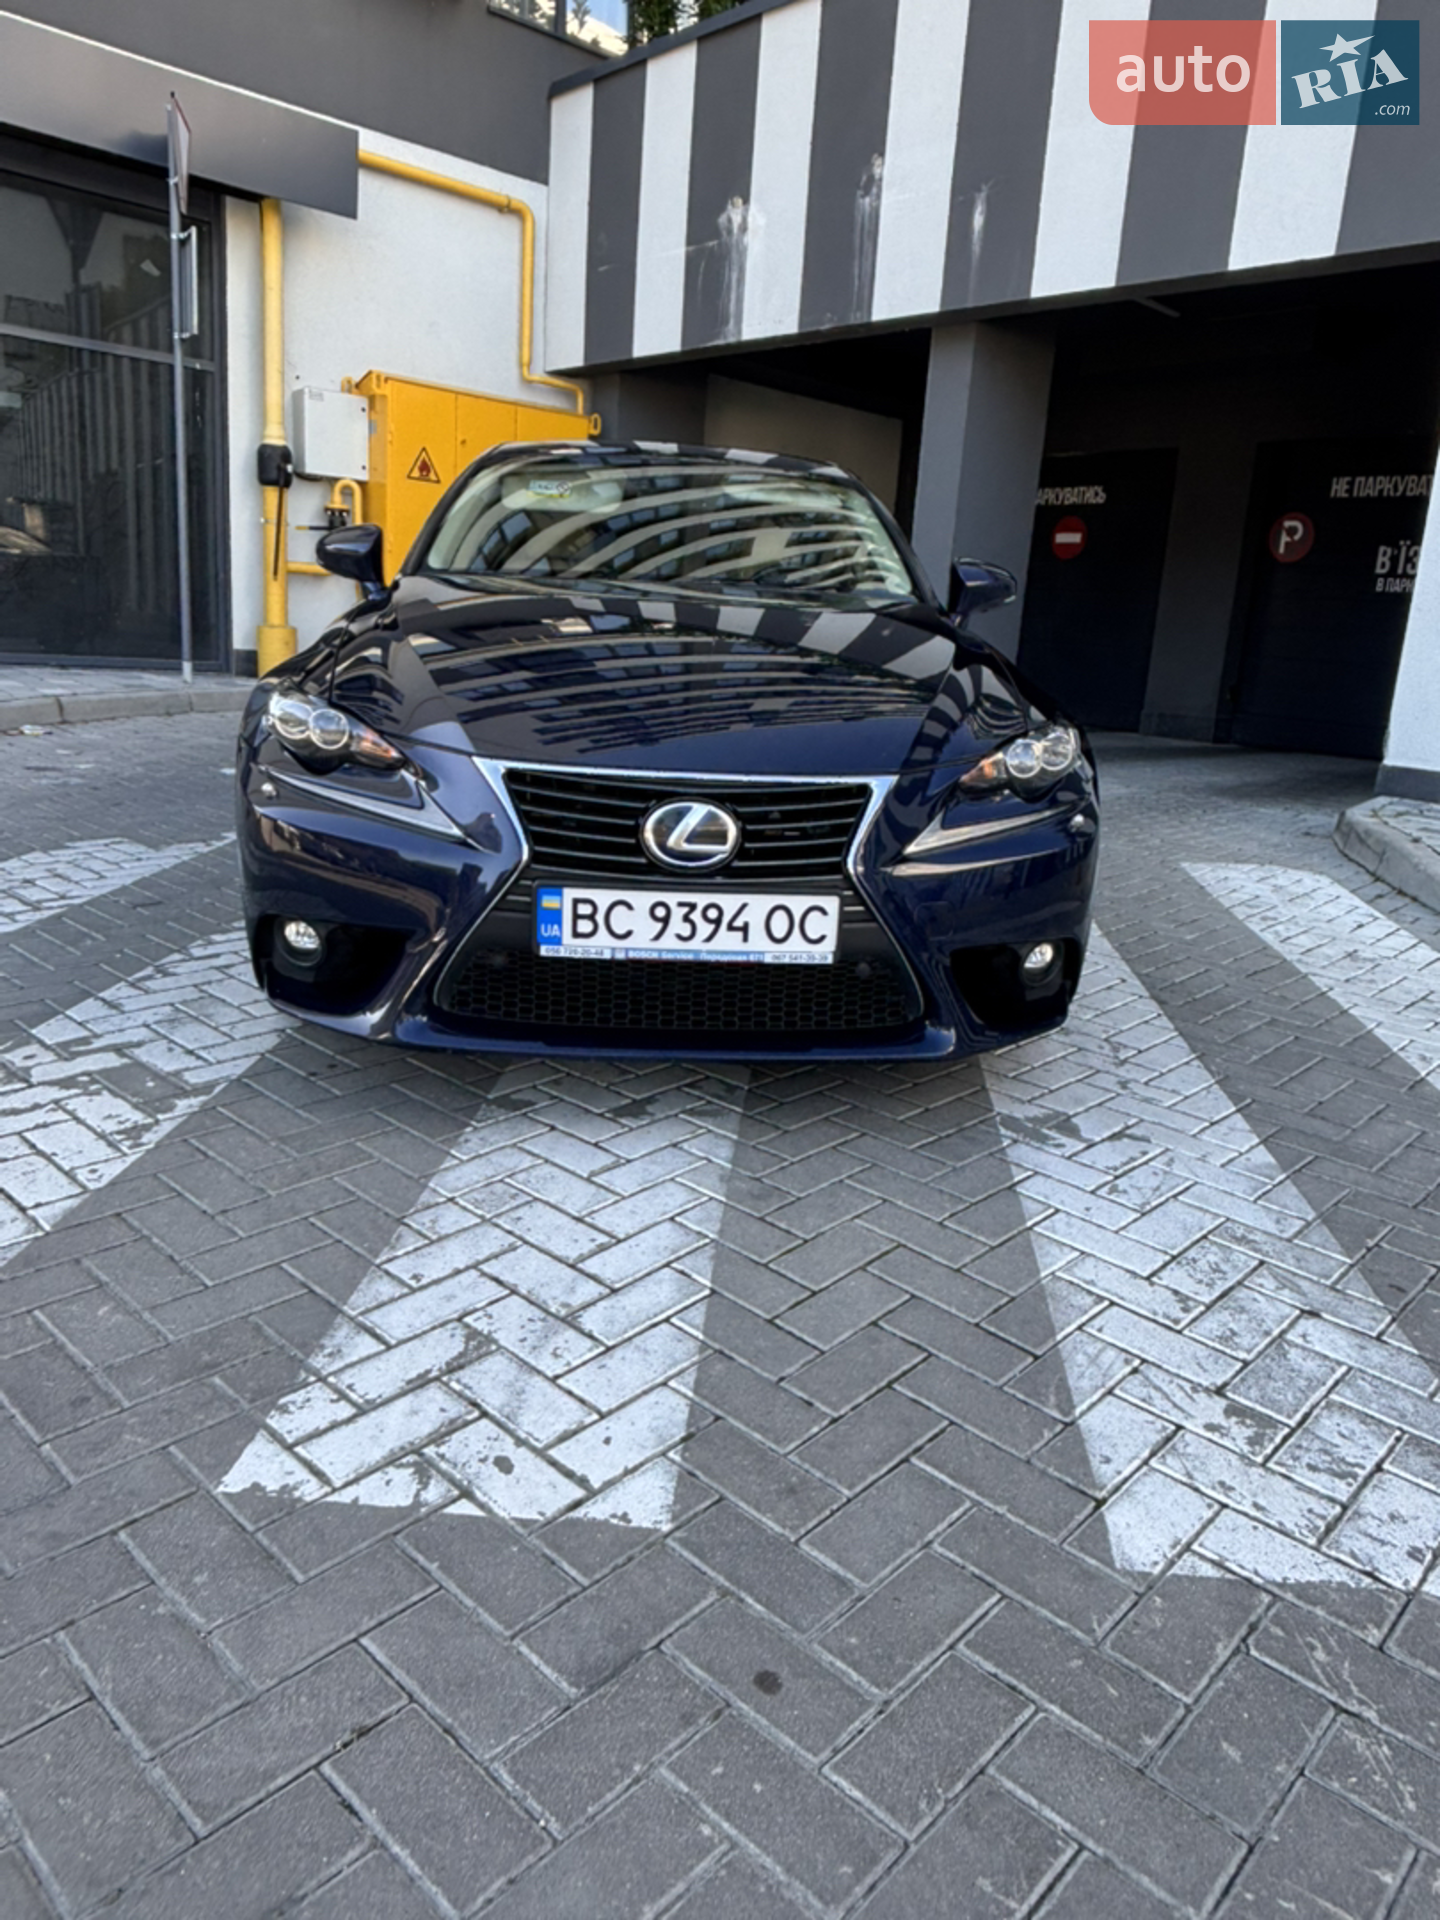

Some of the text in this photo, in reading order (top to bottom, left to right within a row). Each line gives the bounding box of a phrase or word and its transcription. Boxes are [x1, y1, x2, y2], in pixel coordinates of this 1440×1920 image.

[1330, 476, 1352, 498] НЕ
[1375, 577, 1385, 593] В
[540, 923, 561, 938] UA
[571, 897, 830, 945] BC 9394 OC
